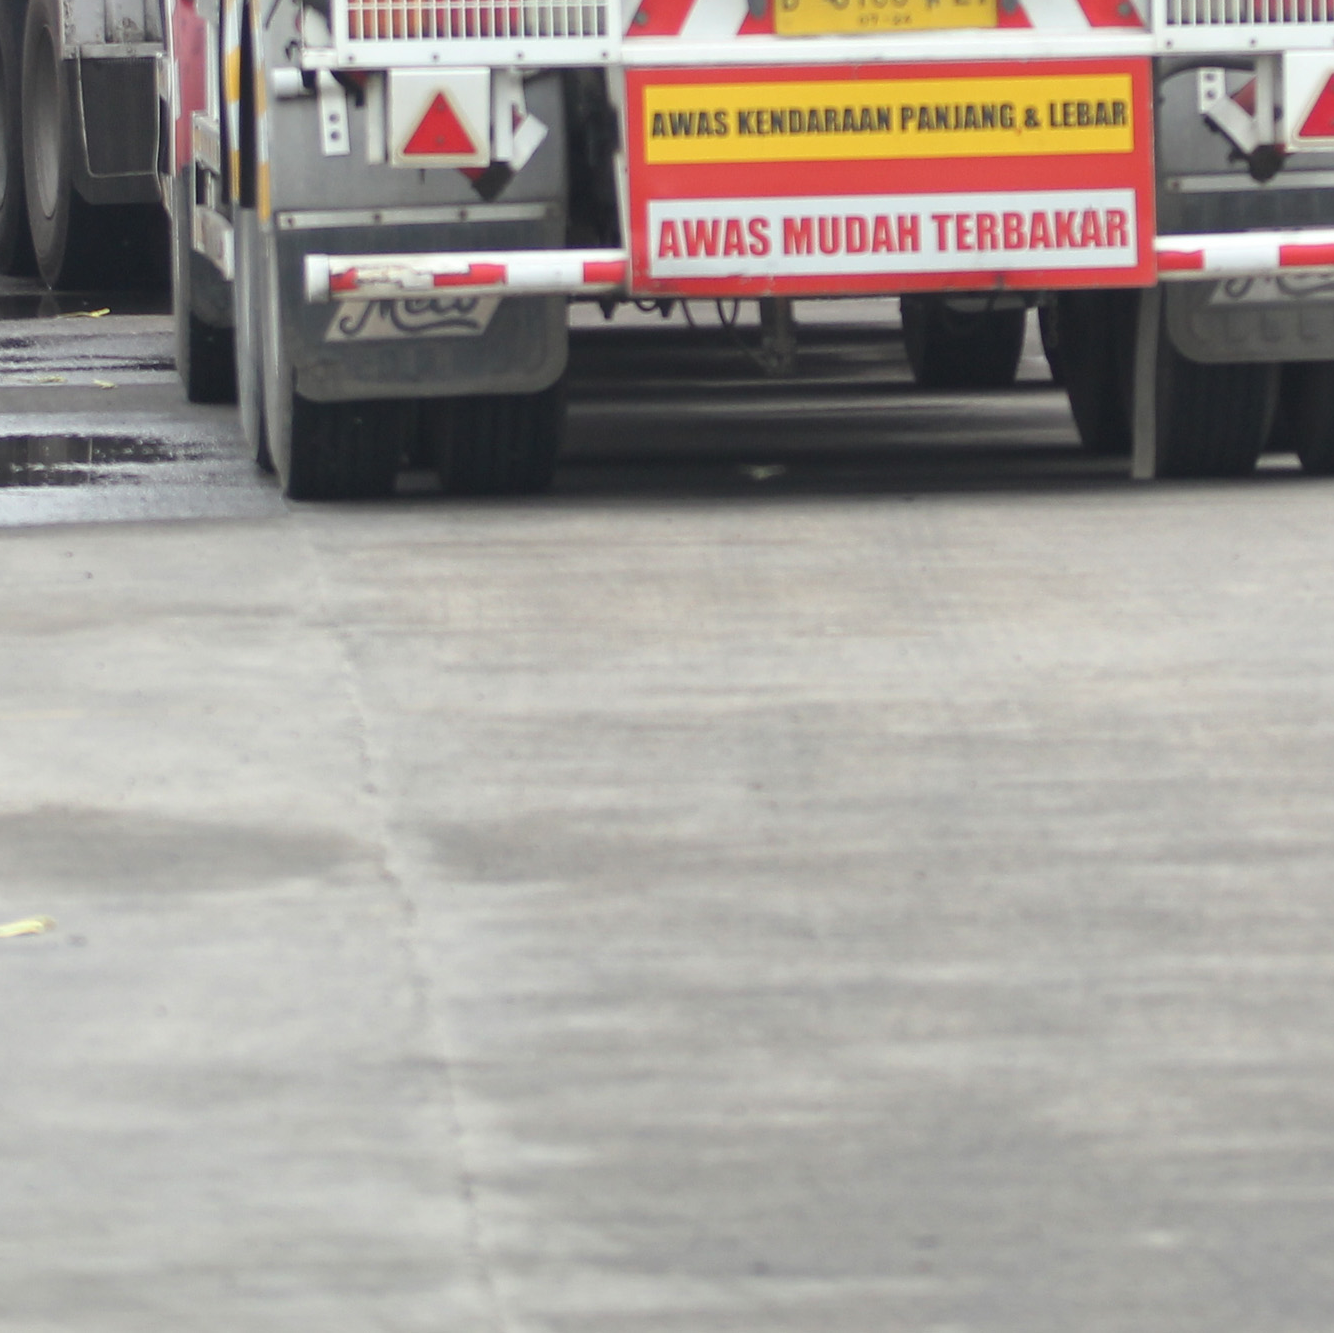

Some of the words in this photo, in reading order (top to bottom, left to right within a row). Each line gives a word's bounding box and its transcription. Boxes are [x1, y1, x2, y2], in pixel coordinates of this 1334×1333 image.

[651, 108, 729, 139] AWAS
[738, 105, 892, 137] KENDARAAN
[900, 102, 1014, 134] PANJANG
[1022, 105, 1041, 129] &
[1049, 99, 1128, 128] LEBAR
[658, 217, 770, 260] AWAS
[782, 214, 920, 256] MUDAH
[931, 208, 1129, 253] TERBAKAR
